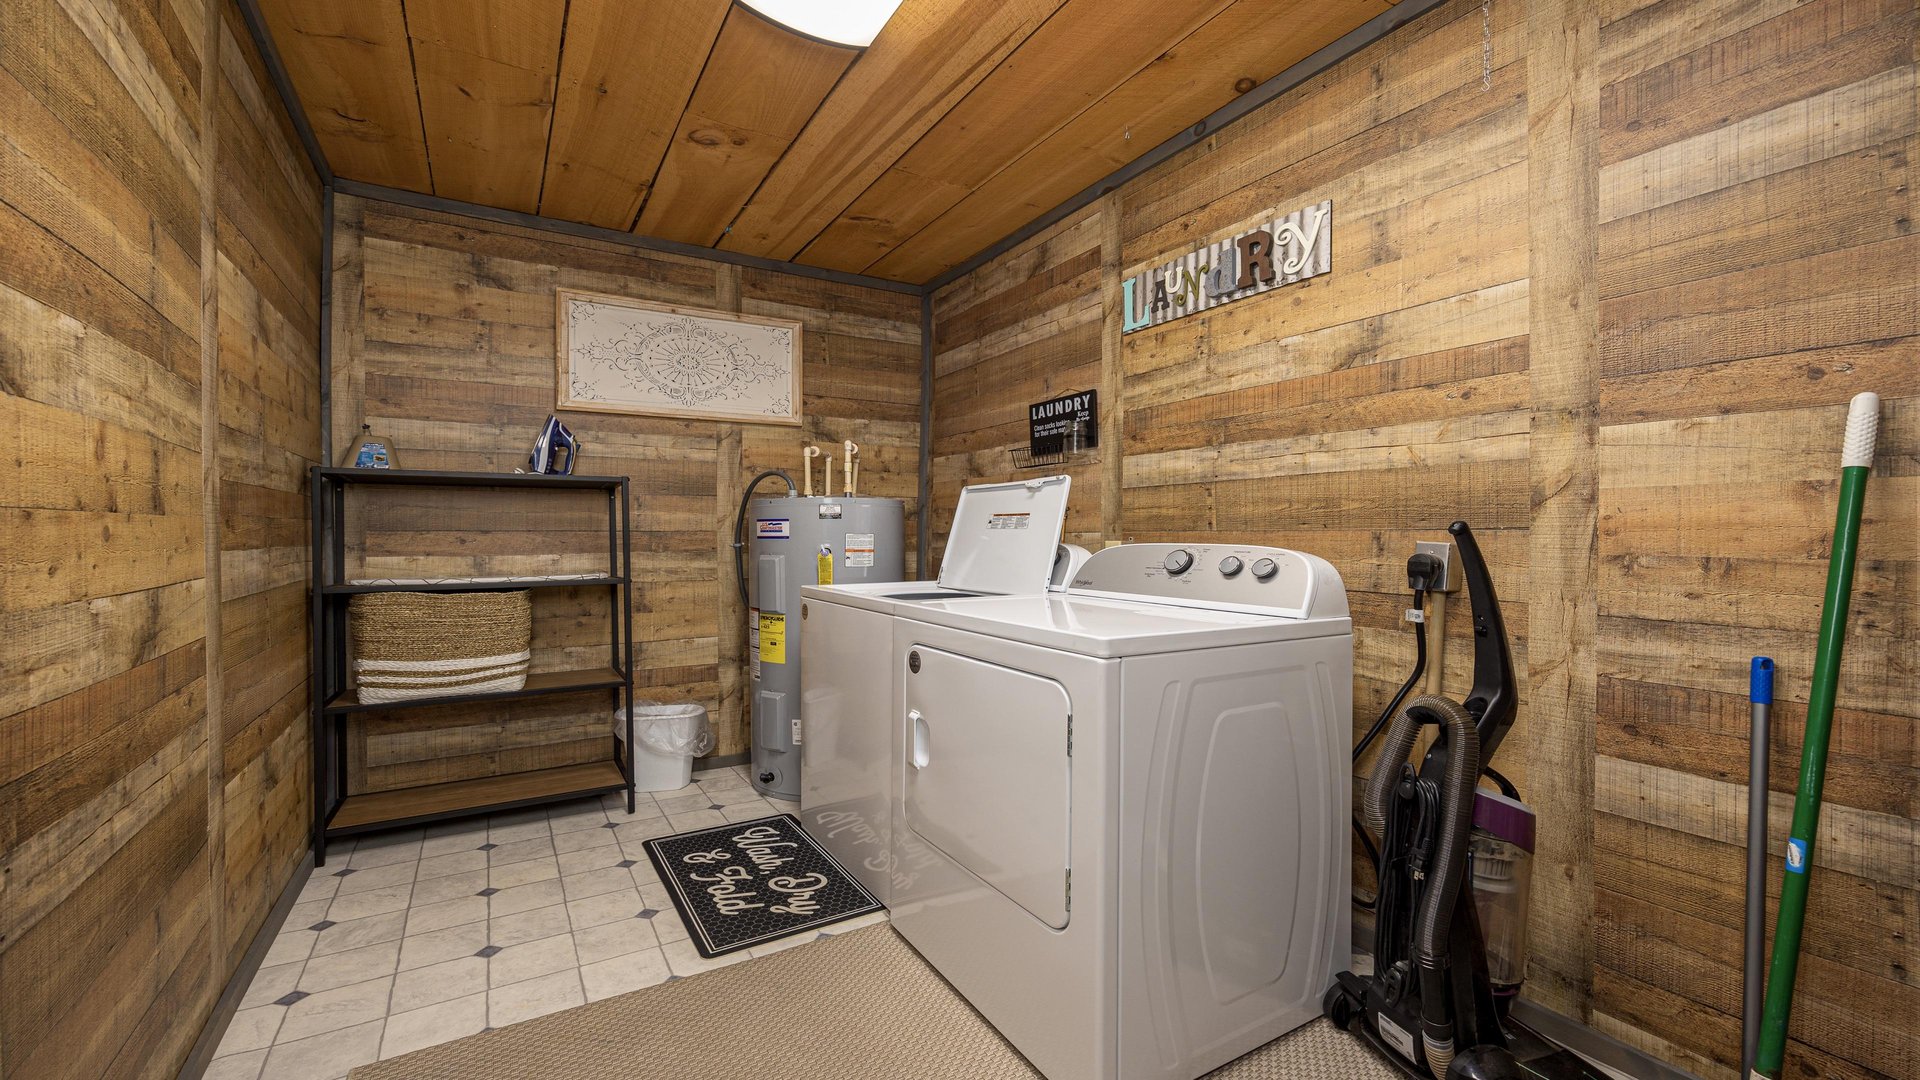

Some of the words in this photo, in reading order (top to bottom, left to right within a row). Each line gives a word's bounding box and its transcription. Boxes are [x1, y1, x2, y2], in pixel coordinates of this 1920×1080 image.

[1032, 394, 1090, 420] LAUNDRY
[683, 848, 731, 864] &
[690, 865, 765, 915] Fold
[768, 872, 828, 915] Dry
